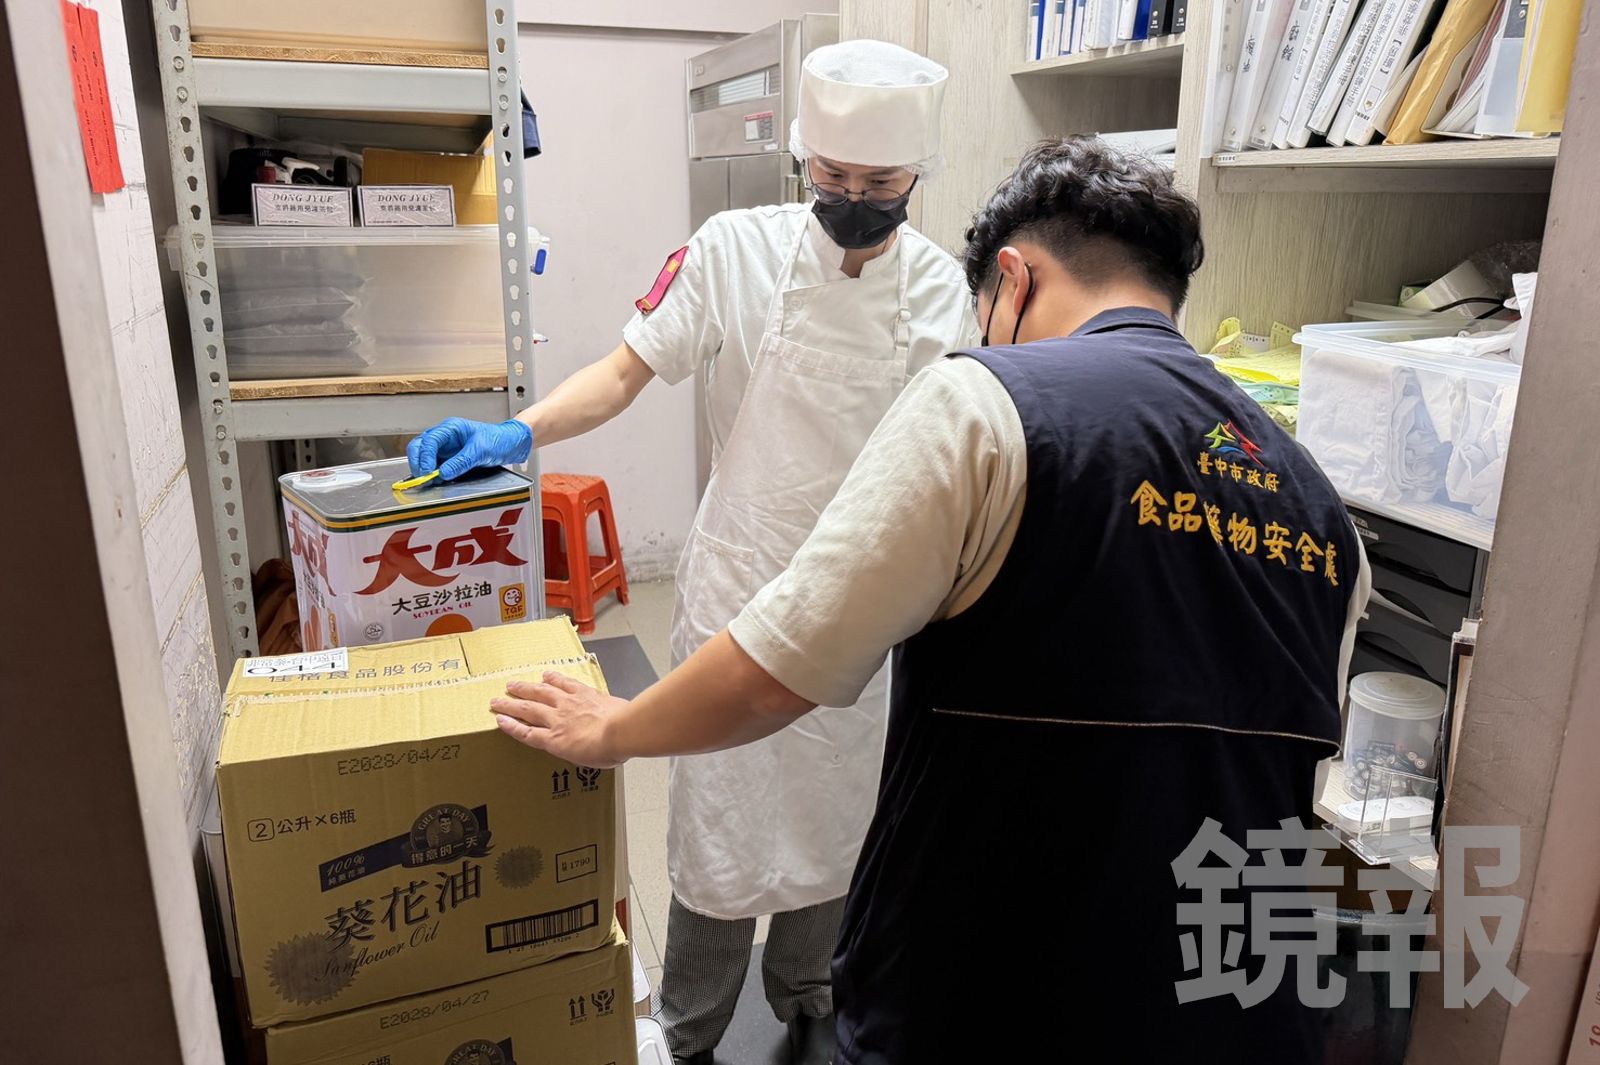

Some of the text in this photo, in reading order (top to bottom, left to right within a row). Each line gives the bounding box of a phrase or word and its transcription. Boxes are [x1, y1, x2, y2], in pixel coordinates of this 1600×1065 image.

[273, 193, 303, 202] DONG
[378, 194, 406, 202] DONG
[1197, 451, 1281, 494] 臺中市政府
[353, 507, 529, 596] 大成
[392, 580, 492, 616] 大豆沙拉油
[338, 744, 461, 776] E2028/04/27
[453, 808, 470, 823] DAY
[255, 823, 268, 838] 2
[327, 853, 366, 877] 100%
[324, 860, 482, 953] 葵花油
[410, 921, 440, 948] Oil
[380, 989, 490, 1030] E2028/04/27
